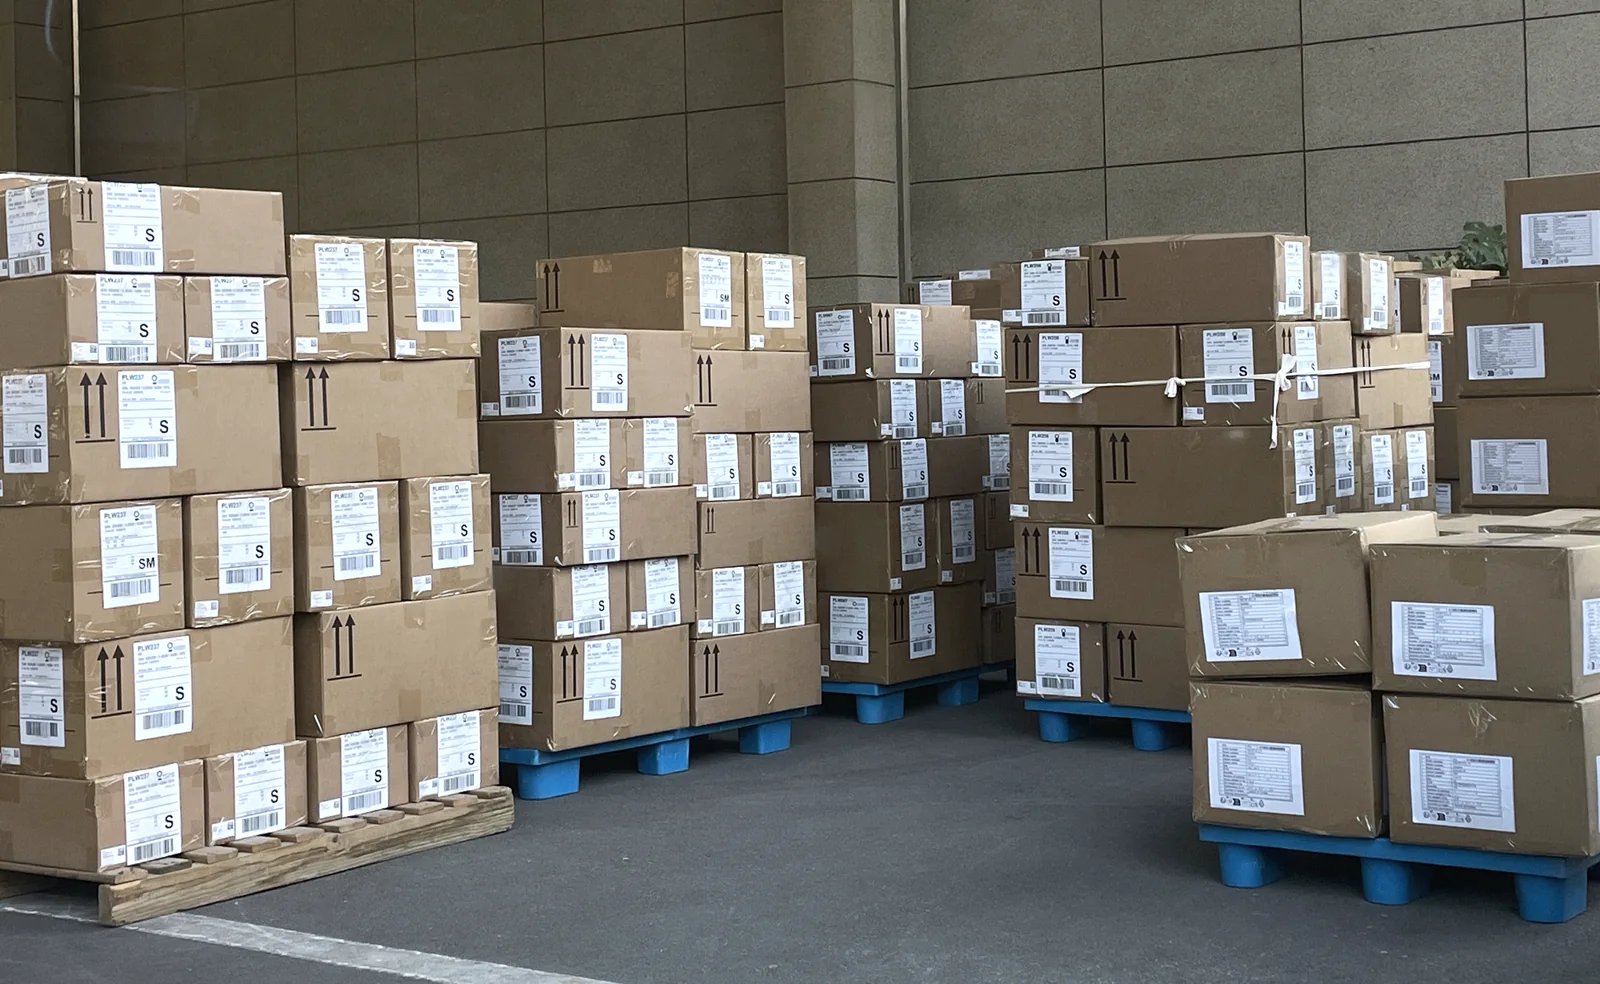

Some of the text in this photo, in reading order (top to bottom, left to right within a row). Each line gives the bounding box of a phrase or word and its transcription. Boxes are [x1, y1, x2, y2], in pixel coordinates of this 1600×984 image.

[38, 232, 44, 248] S
[146, 228, 154, 242] S
[352, 288, 360, 302] S
[446, 290, 454, 302] S
[784, 294, 790, 304] S
[1052, 296, 1060, 306] S
[140, 324, 148, 338] S
[250, 322, 260, 334] S
[844, 342, 850, 352] S
[914, 342, 918, 352] S
[994, 350, 998, 360] S
[1068, 368, 1076, 380] S
[1238, 366, 1248, 376] S
[528, 376, 536, 388] S
[616, 374, 624, 384] S
[908, 412, 914, 422] S
[958, 410, 962, 420] S
[34, 424, 42, 438] S
[160, 420, 168, 434] S
[600, 454, 606, 466] S
[668, 454, 674, 466] S
[730, 468, 734, 478] S
[792, 466, 796, 476] S
[858, 472, 864, 482] S
[920, 470, 926, 480] S
[1060, 466, 1068, 478] S
[460, 524, 468, 536] S
[608, 528, 616, 540] S
[366, 532, 374, 546] S
[530, 532, 538, 544] S
[918, 536, 922, 546] S
[256, 544, 264, 558] S
[139, 557, 155, 569] SM
[1080, 564, 1088, 576] S
[670, 592, 676, 604] S
[796, 594, 800, 604] S
[598, 600, 604, 612] S
[736, 604, 740, 614] S
[856, 630, 864, 640] S
[928, 624, 932, 634] S
[138, 643, 159, 652] PLW237
[1066, 662, 1074, 672] S
[610, 678, 616, 690] S
[176, 686, 184, 700] S
[520, 686, 526, 698] S
[50, 698, 58, 712] S
[468, 752, 474, 766] S
[374, 770, 382, 782] S
[270, 790, 278, 804] S
[164, 814, 174, 828] S
